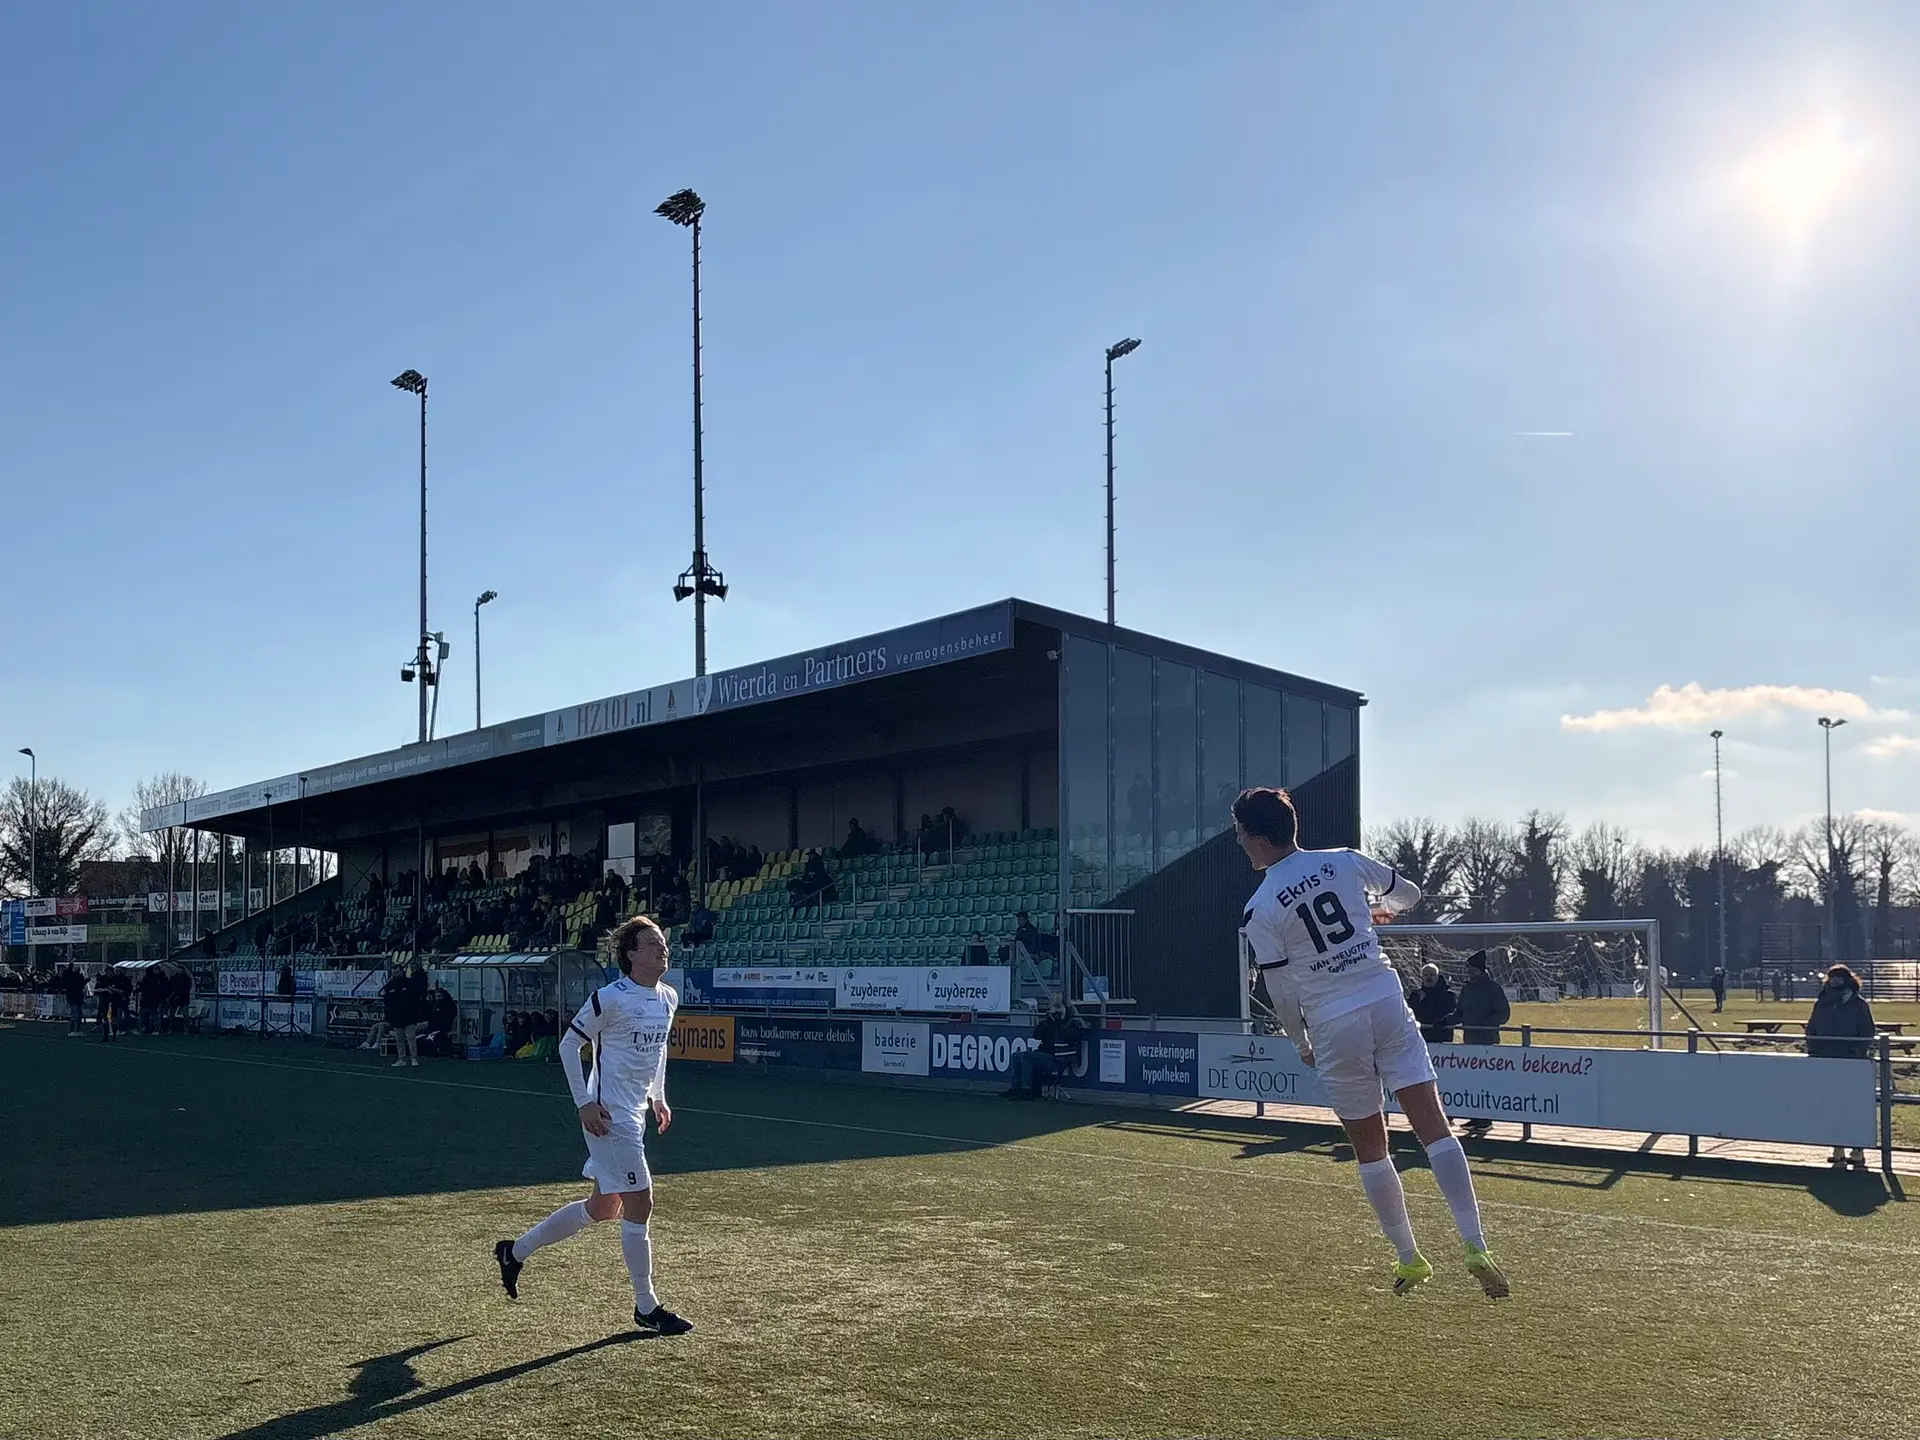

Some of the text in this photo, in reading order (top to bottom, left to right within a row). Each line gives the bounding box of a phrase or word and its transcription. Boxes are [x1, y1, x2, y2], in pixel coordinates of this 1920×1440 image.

[717, 630, 1003, 704] Wierda en Partners Vermogensbeheer
[576, 690, 653, 737] HZ101.nl
[199, 892, 217, 904] Gent
[1276, 873, 1321, 908] Ekris
[1295, 891, 1356, 954] 19
[1309, 940, 1371, 972] VAN HEUGTEN
[850, 982, 898, 1000] zuyderzee
[934, 983, 988, 1002] zuyderzee
[803, 1030, 824, 1041] onze
[826, 1028, 855, 1043] details
[874, 1027, 916, 1048] baderie
[1137, 1041, 1195, 1060] verzekeringen
[1142, 1063, 1190, 1084] hypotheken
[1432, 1051, 1593, 1076] artwensen bekend?
[1208, 1068, 1300, 1097] DE GROOT
[627, 1171, 637, 1185] 9
